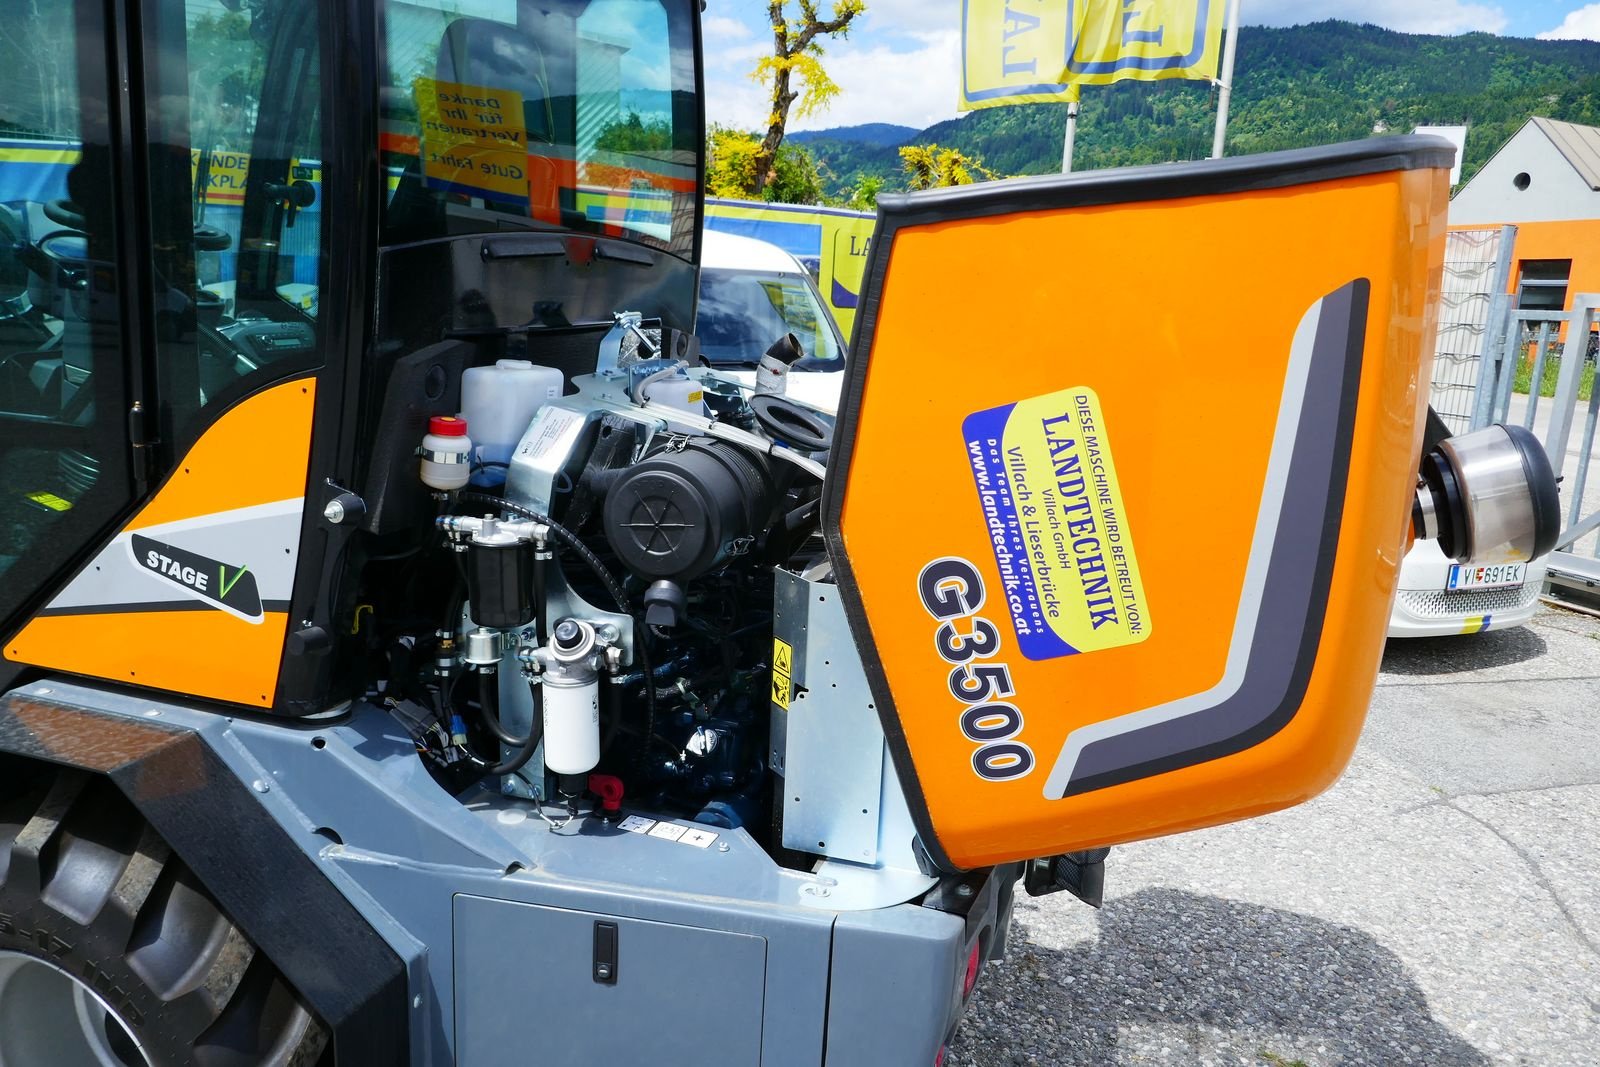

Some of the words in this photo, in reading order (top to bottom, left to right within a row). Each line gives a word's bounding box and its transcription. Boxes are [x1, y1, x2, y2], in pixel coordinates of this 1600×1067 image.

[1075, 395, 1095, 433] DIESE
[1007, 446, 1033, 501] Villach
[1084, 436, 1113, 505] MASCHINE
[968, 440, 1031, 636] www.landtechnik.co.at
[987, 438, 1000, 464] Das
[995, 471, 1012, 507] Team
[1006, 513, 1023, 552] Ihres
[1018, 558, 1044, 634] Vertrauens
[1021, 505, 1037, 517] &
[1041, 412, 1119, 631] LANDTECHNIK
[1041, 488, 1062, 530] Villach
[1052, 532, 1072, 569] GmbH
[1102, 507, 1121, 543] WIRD
[146, 550, 209, 591] STAGE
[218, 564, 247, 599] V
[1025, 521, 1061, 618] Lieserbrücke
[1111, 545, 1136, 601] BETREUT
[1125, 603, 1142, 635] VON:
[917, 556, 1036, 782] G3500
